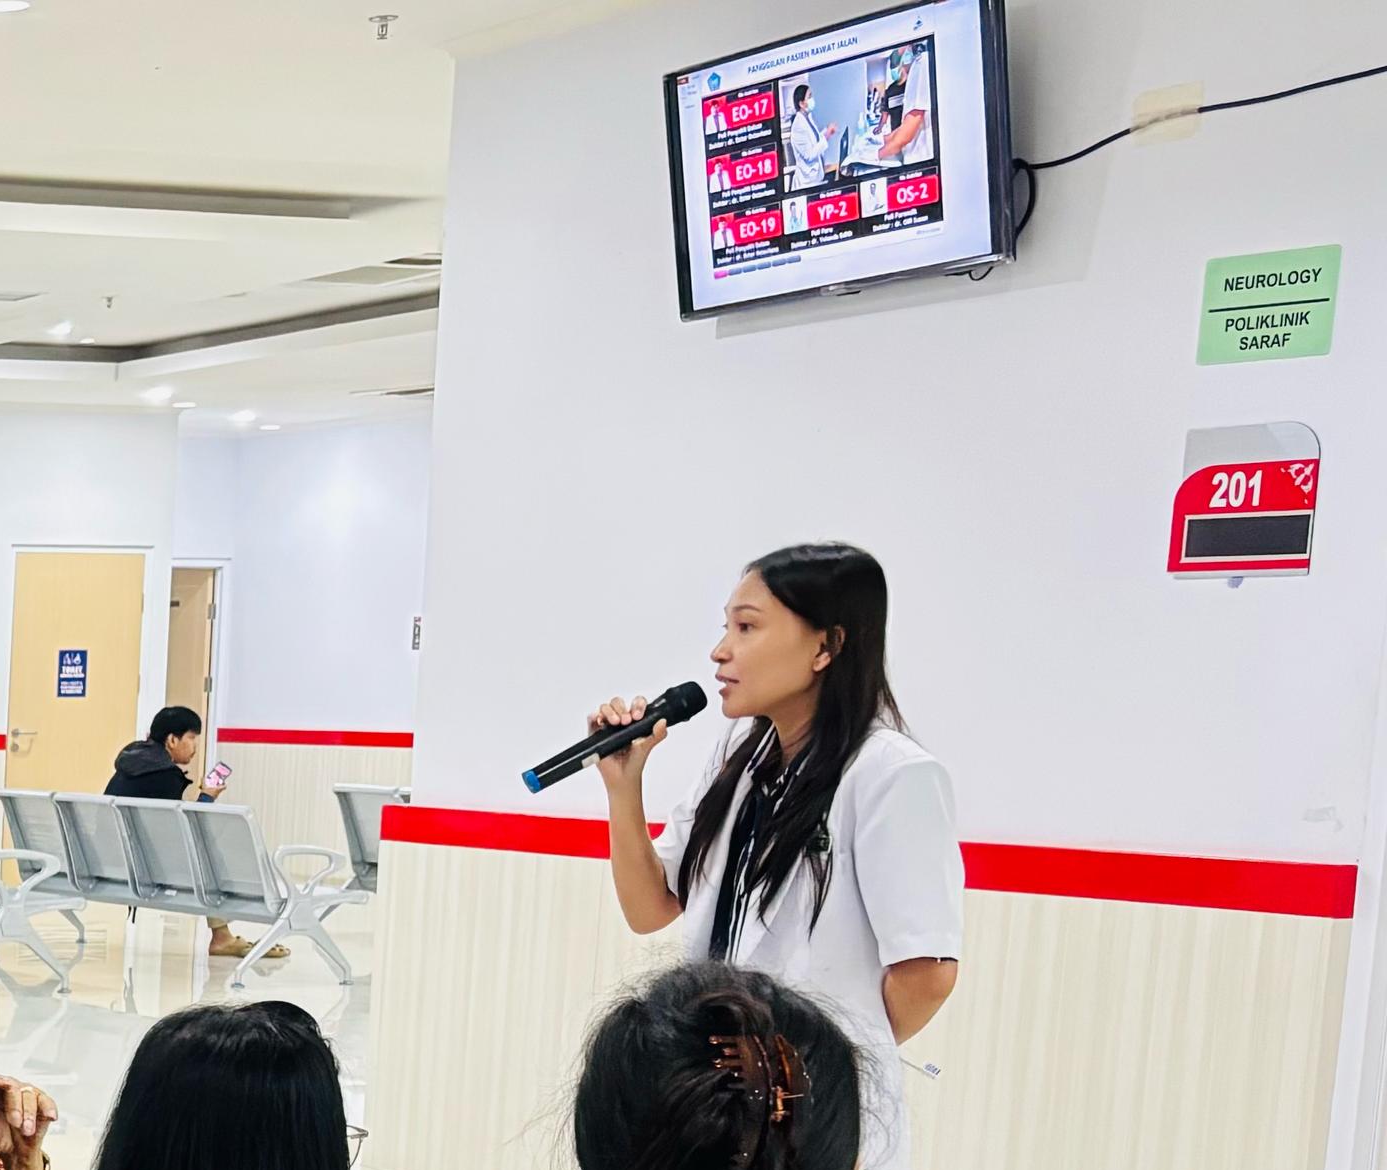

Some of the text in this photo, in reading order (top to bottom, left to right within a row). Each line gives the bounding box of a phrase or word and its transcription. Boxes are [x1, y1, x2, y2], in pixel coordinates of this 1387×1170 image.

[786, 51, 810, 64] PASIEN
[811, 42, 836, 57] RAWAT
[837, 36, 859, 49] JALAN
[732, 97, 769, 122] EO-17
[735, 158, 772, 181] EO-18
[896, 182, 929, 204] OS-2
[817, 201, 848, 221] YP-2
[739, 217, 776, 239] EO-19
[1223, 267, 1323, 293] NEUROLOGY
[1224, 310, 1312, 333] POLIKLINIK
[1239, 332, 1292, 351] SARAF
[1208, 469, 1263, 508] 201
